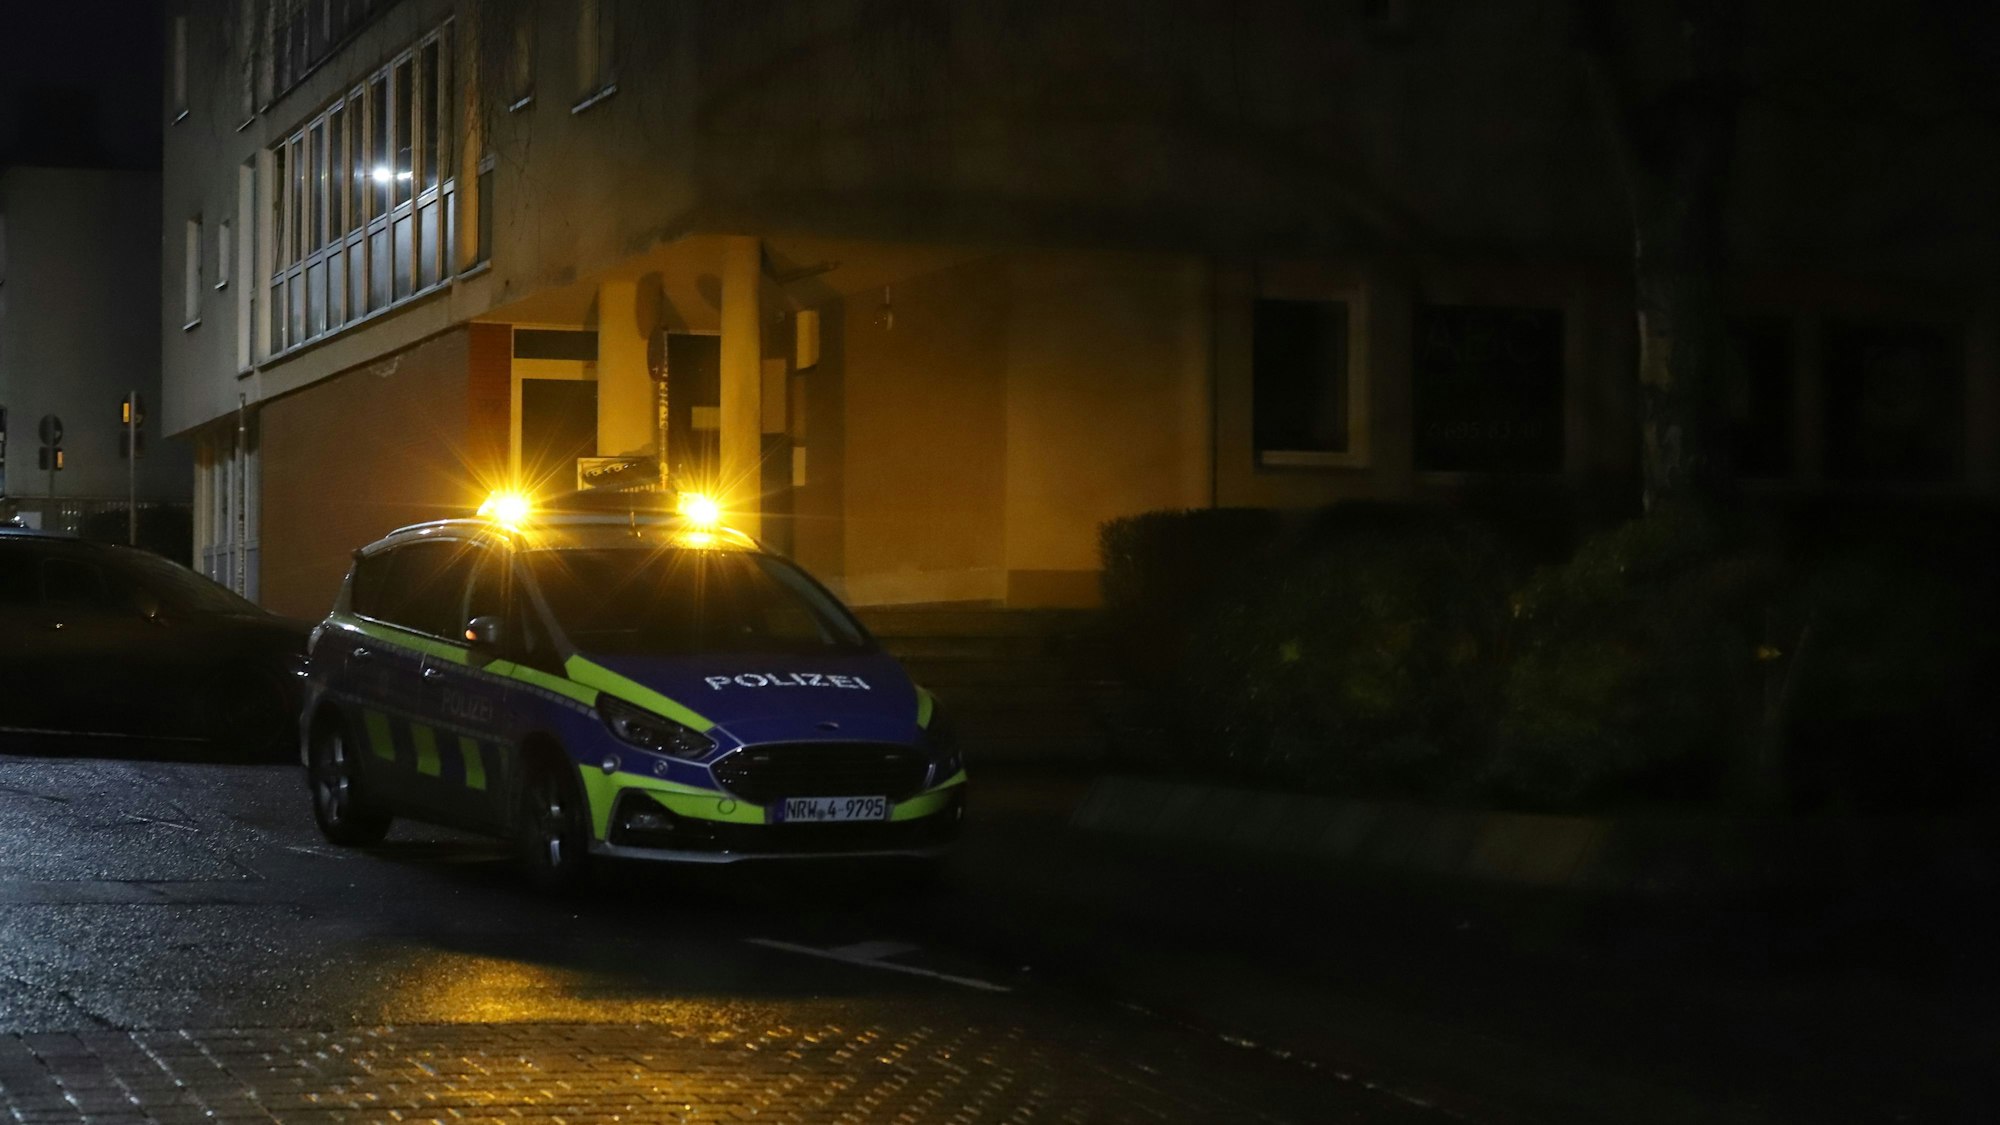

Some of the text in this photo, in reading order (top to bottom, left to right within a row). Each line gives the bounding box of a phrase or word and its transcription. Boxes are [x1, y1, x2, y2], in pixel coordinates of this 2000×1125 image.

[704, 672, 872, 691] POLIZEI
[441, 687, 493, 722] POLIZEI
[786, 800, 818, 819] NRW
